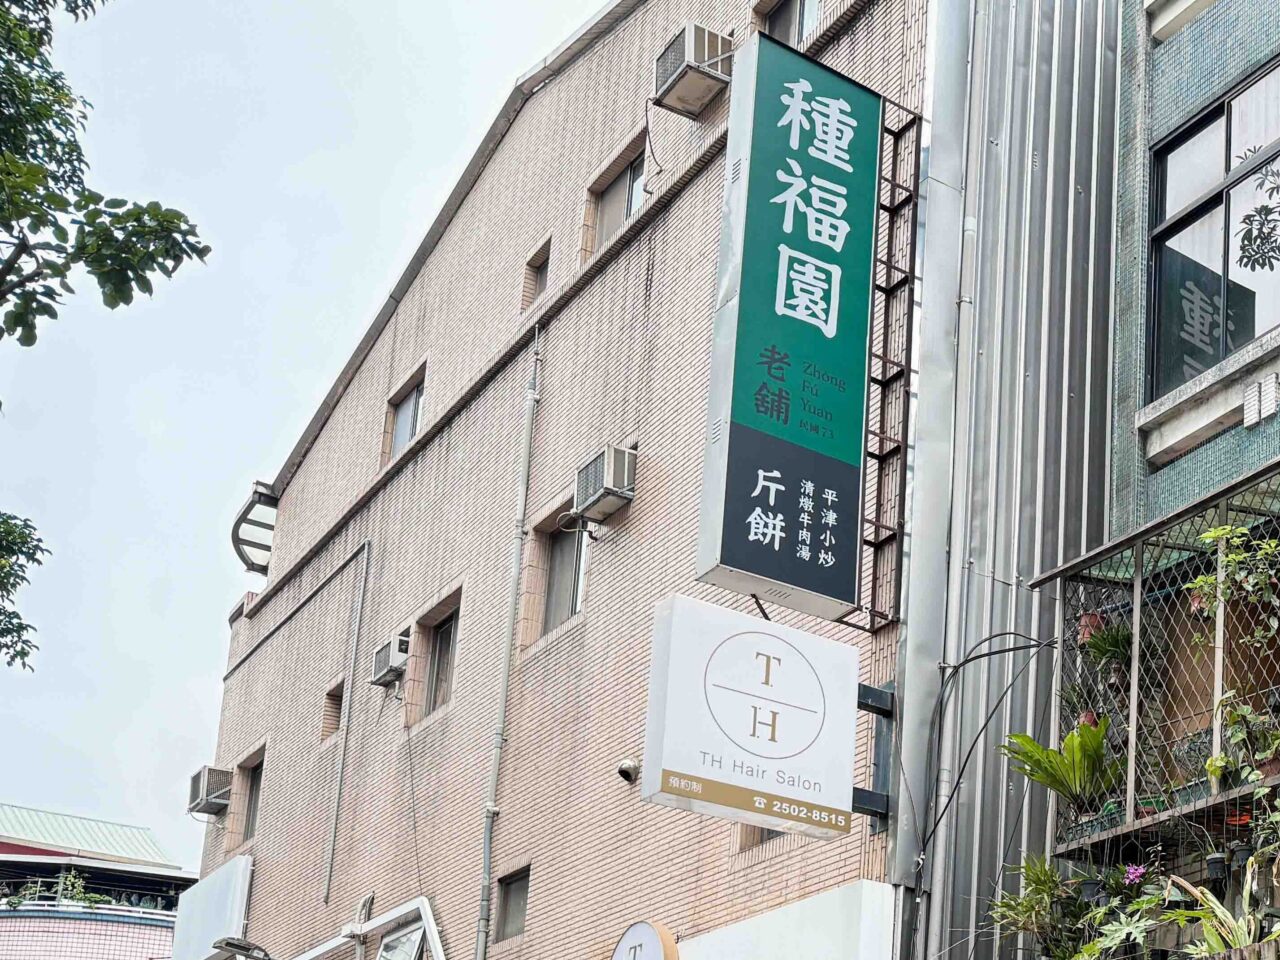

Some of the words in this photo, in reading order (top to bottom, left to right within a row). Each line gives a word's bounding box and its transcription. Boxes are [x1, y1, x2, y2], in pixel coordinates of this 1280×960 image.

[769, 78, 858, 339] 種福園
[746, 469, 787, 551] 斤餅
[796, 479, 815, 562] 清燉牛肉湯
[818, 488, 839, 568] 平津小炒
[755, 651, 782, 688] T
[749, 705, 780, 744] H
[700, 751, 723, 770] TH
[732, 759, 768, 780] Hair
[776, 769, 822, 793] Salon
[772, 800, 846, 827] 2502-8515
